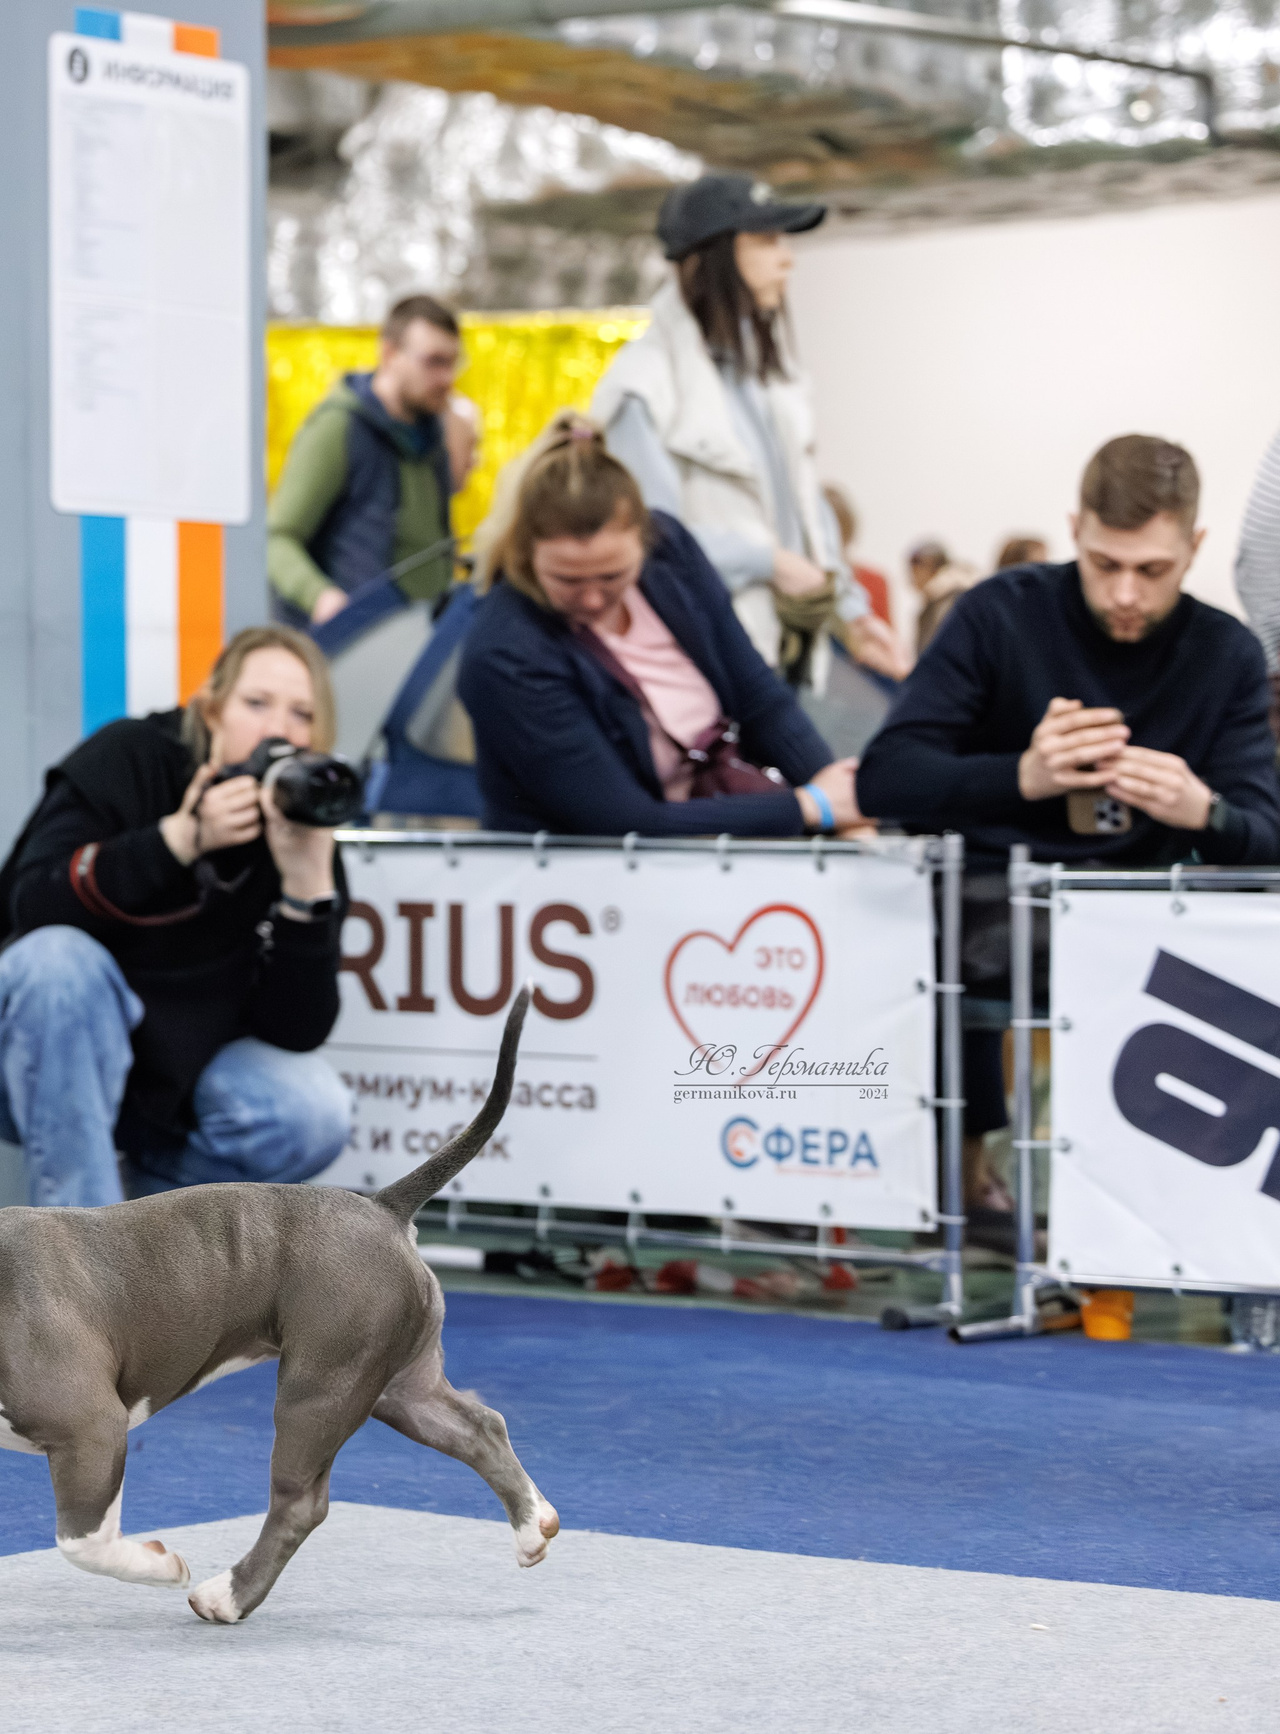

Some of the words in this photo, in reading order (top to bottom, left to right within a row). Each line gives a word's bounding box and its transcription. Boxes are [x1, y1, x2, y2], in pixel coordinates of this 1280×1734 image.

[755, 946, 807, 970] ЭТО
[684, 983, 796, 1010] ЛЮБОВЬ
[721, 1115, 879, 1170] СФЕРА
